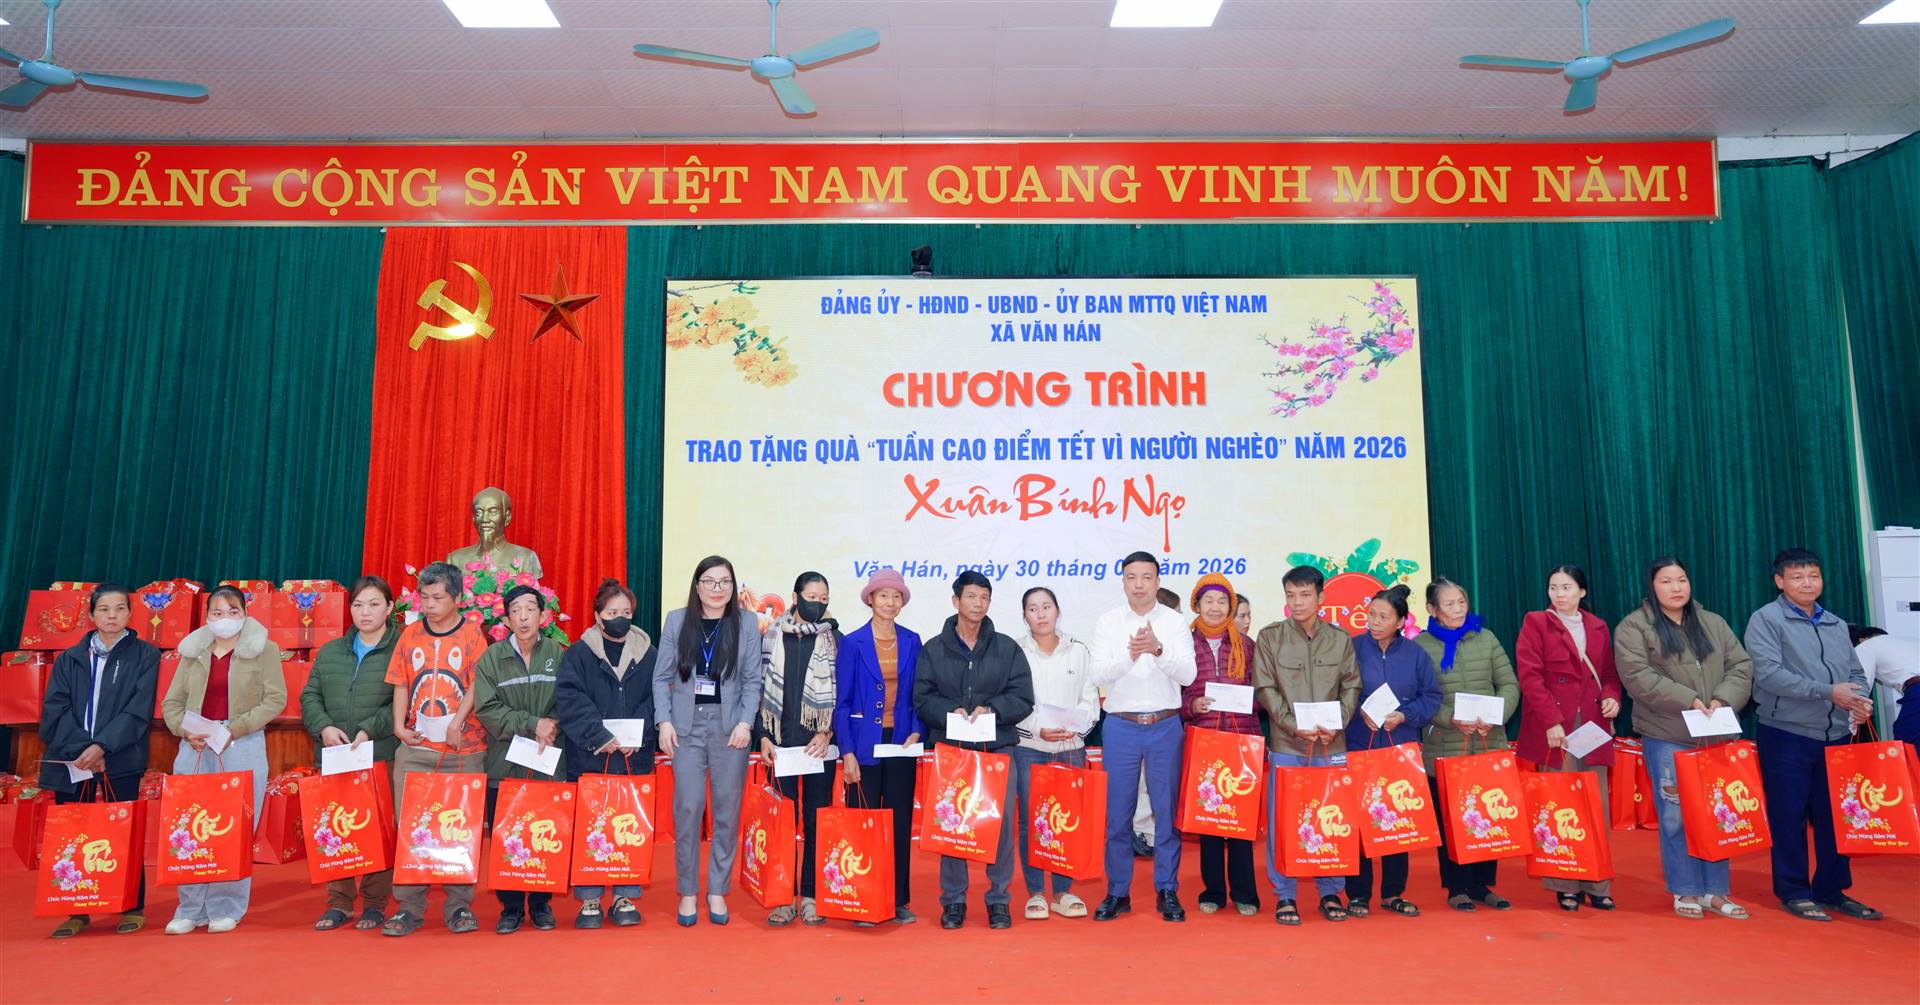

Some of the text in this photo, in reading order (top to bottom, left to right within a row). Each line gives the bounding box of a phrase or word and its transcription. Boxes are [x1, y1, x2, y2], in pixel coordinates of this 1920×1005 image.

[77, 151, 1687, 215] ĐẢNG CỘNG SẢN VIỆT NAM QUANG VINH MUÔN NĂM!
[820, 289, 872, 315] ĐẢNG
[877, 289, 901, 314] ỦY
[918, 295, 970, 315] HĐND
[988, 295, 1039, 314] UBND
[1056, 288, 1077, 314] ỦY
[1085, 295, 1124, 314] BAN
[1128, 295, 1177, 316] MTTQ
[1181, 291, 1221, 318] VIỆT
[1225, 295, 1268, 314] NAM
[991, 320, 1102, 342] XÃ VĂN HÁN
[883, 362, 1207, 407] CHƯƠNG TRÌNH
[685, 439, 743, 463] TRAO
[749, 435, 808, 468] TẶNG
[814, 434, 860, 465] QUÀ
[942, 438, 987, 461] CAO
[993, 429, 1052, 461] ĐIỂM
[1057, 430, 1096, 460] TẾT
[1102, 432, 1123, 460] VÌ
[1130, 431, 1198, 460] NGƯỜI
[1295, 431, 1346, 459] NĂM
[1353, 436, 1407, 460] 2026
[904, 474, 1186, 553] Xuân Bính Ngọ
[901, 560, 948, 580] Hán,
[1015, 560, 1041, 577] 30
[1047, 560, 1108, 581] tháng
[1159, 558, 1190, 576] ăm
[1198, 558, 1247, 576] 2026
[1320, 601, 1369, 629] Tế
